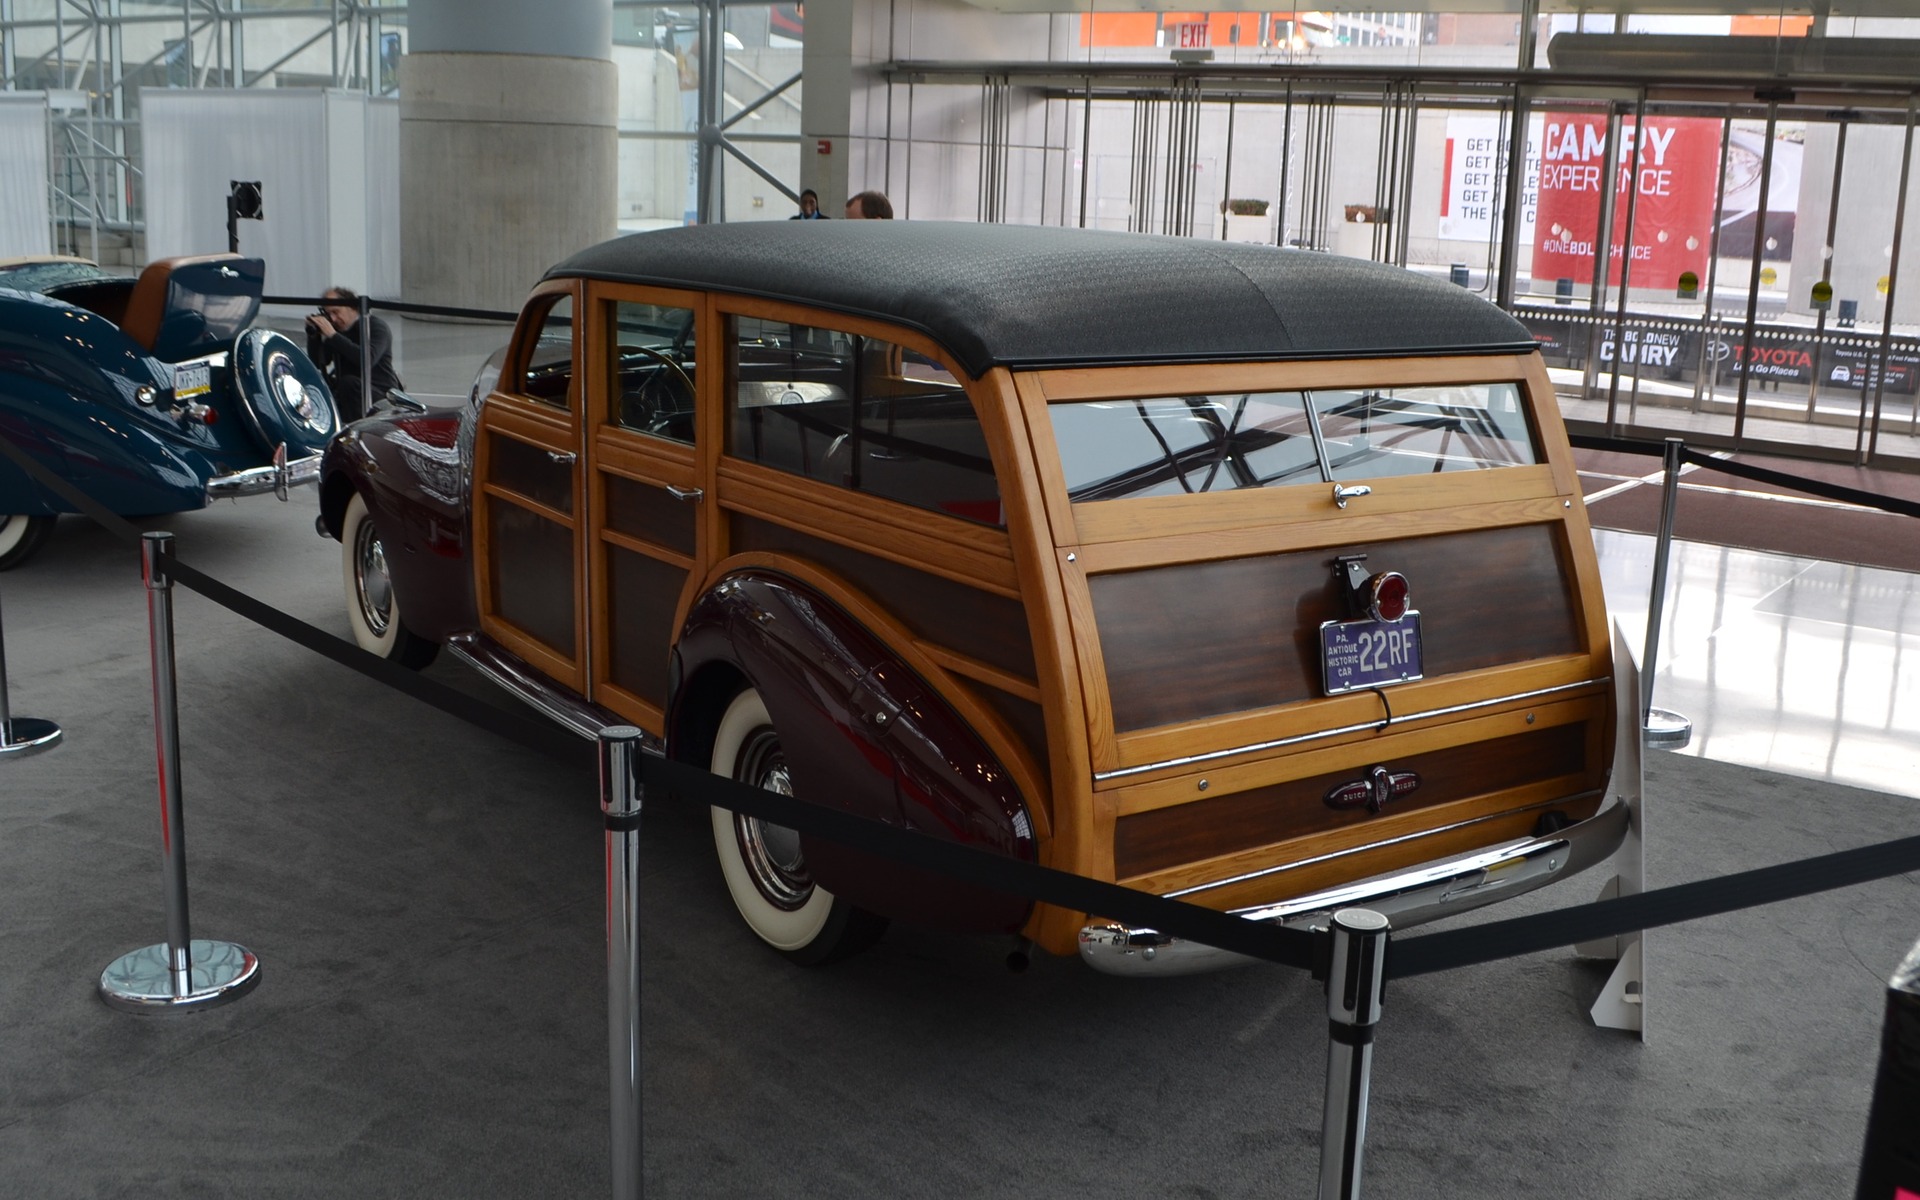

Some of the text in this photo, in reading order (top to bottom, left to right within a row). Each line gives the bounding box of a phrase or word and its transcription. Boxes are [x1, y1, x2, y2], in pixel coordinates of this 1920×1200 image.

[1181, 24, 1208, 48] EXIT
[1467, 138, 1492, 151] GET
[1545, 122, 1676, 166] CAMRY
[1465, 156, 1491, 169] GET
[1464, 173, 1490, 186] GET
[1543, 164, 1672, 196] EXPERNCE
[1462, 190, 1488, 203] GET
[1461, 206, 1487, 220] THE
[1543, 239, 1652, 260] #ONEBOLHICE
[1733, 345, 1812, 367] TOYOTA
[1755, 364, 1767, 374] Go
[1769, 365, 1800, 377] Places
[1335, 634, 1349, 644] PA.
[1328, 643, 1358, 656] ANTIQUE
[1358, 628, 1414, 673] 22RF
[1328, 655, 1359, 668] HISTORIC
[1337, 667, 1352, 677] CAR
